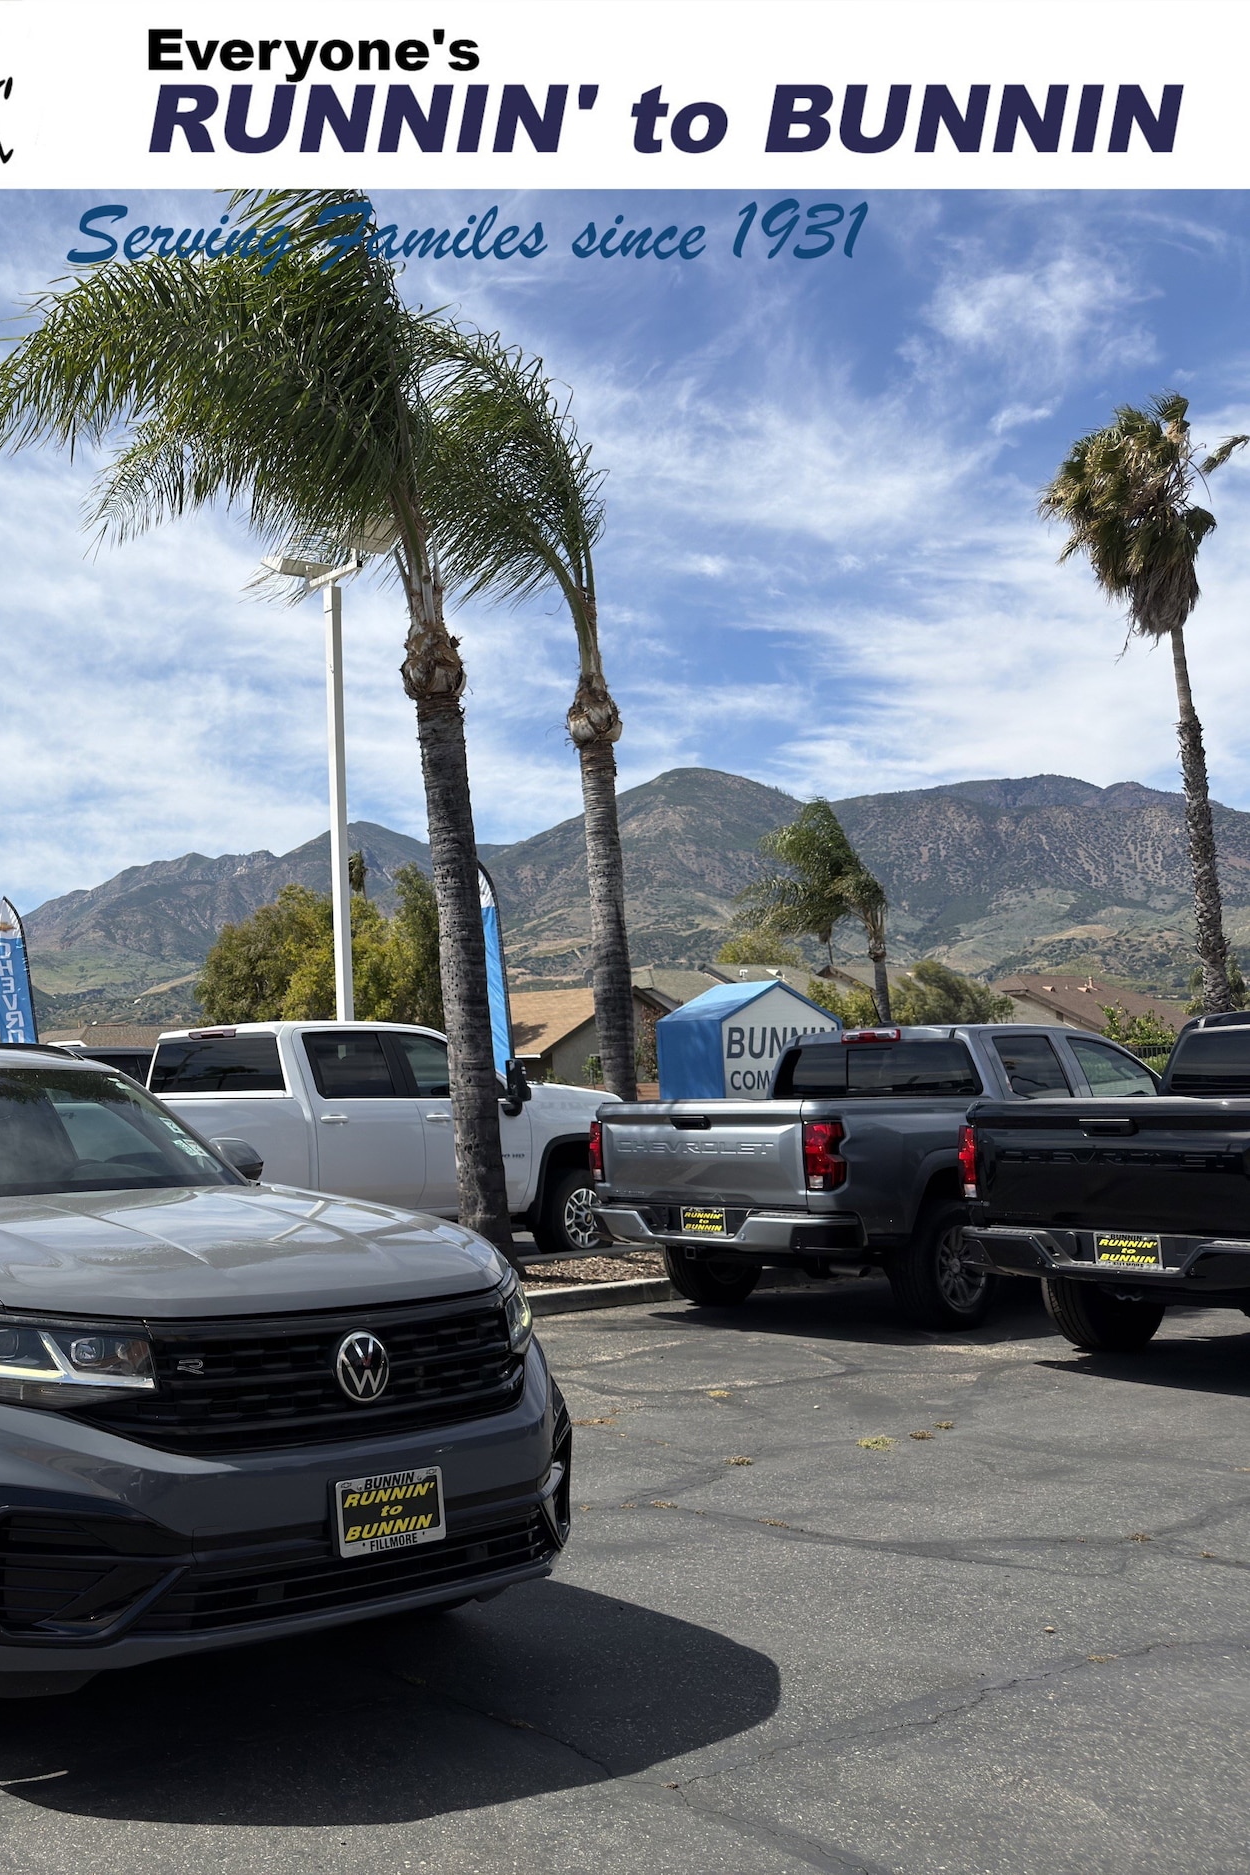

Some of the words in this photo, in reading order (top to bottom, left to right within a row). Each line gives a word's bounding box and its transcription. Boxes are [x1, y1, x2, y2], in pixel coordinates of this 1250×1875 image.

[616, 1140, 775, 1155] CHEVROLET
[1098, 1239, 1158, 1249] RUNNIN'
[1100, 1253, 1156, 1263] BUNNIN
[364, 1472, 415, 1491] BUNNIN
[343, 1481, 436, 1509] RUNNIN'
[380, 1504, 404, 1518] to
[344, 1513, 433, 1542] BUNNIN
[370, 1532, 418, 1552] FILLMORE
